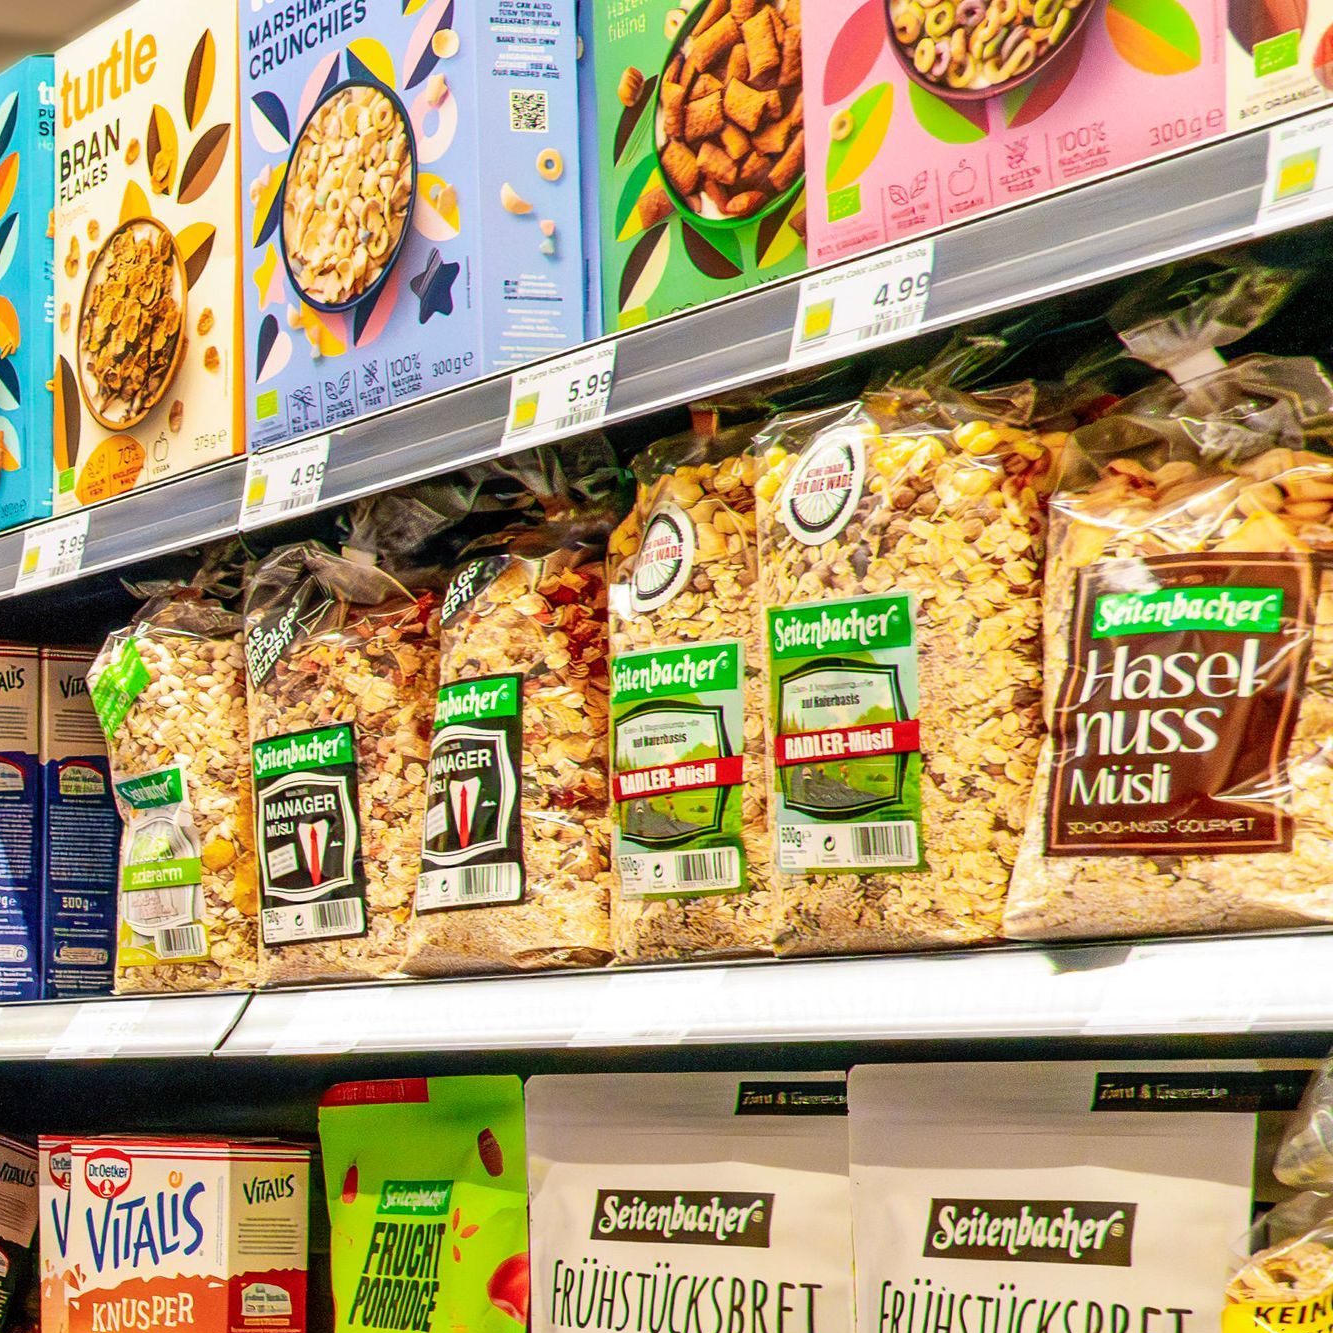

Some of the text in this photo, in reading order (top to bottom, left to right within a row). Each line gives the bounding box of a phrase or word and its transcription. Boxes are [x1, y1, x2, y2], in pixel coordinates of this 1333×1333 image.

[249, 0, 367, 80] CRUNCHIES
[59, 27, 159, 128] turtle
[58, 119, 123, 185] BRAN
[58, 162, 111, 207] FLAKES
[873, 271, 932, 309] 4.99
[389, 352, 422, 378] 100%
[567, 370, 613, 404] 5.99
[290, 461, 327, 488] 4.99
[826, 472, 854, 492] WADE
[56, 533, 87, 559] 3.99
[655, 544, 684, 562] WADE
[773, 605, 899, 652] Seitenbacher
[1094, 592, 1279, 632] Seitenbacher
[249, 628, 294, 688] REZEPT!
[1076, 637, 1269, 704] Hasel
[254, 730, 345, 777] Seitenbacher
[783, 727, 895, 761] RADLER-Müsli
[1074, 706, 1223, 758] nuss
[1069, 763, 1173, 808] Müsli
[265, 794, 337, 823] MANAGER
[266, 821, 295, 840] MÜSLI
[601, 1195, 754, 1242] Seitenbacher
[937, 1204, 1112, 1258] Seitenbacher
[362, 1219, 446, 1281] FRUCHT
[347, 1276, 442, 1333] PORRIDGE
